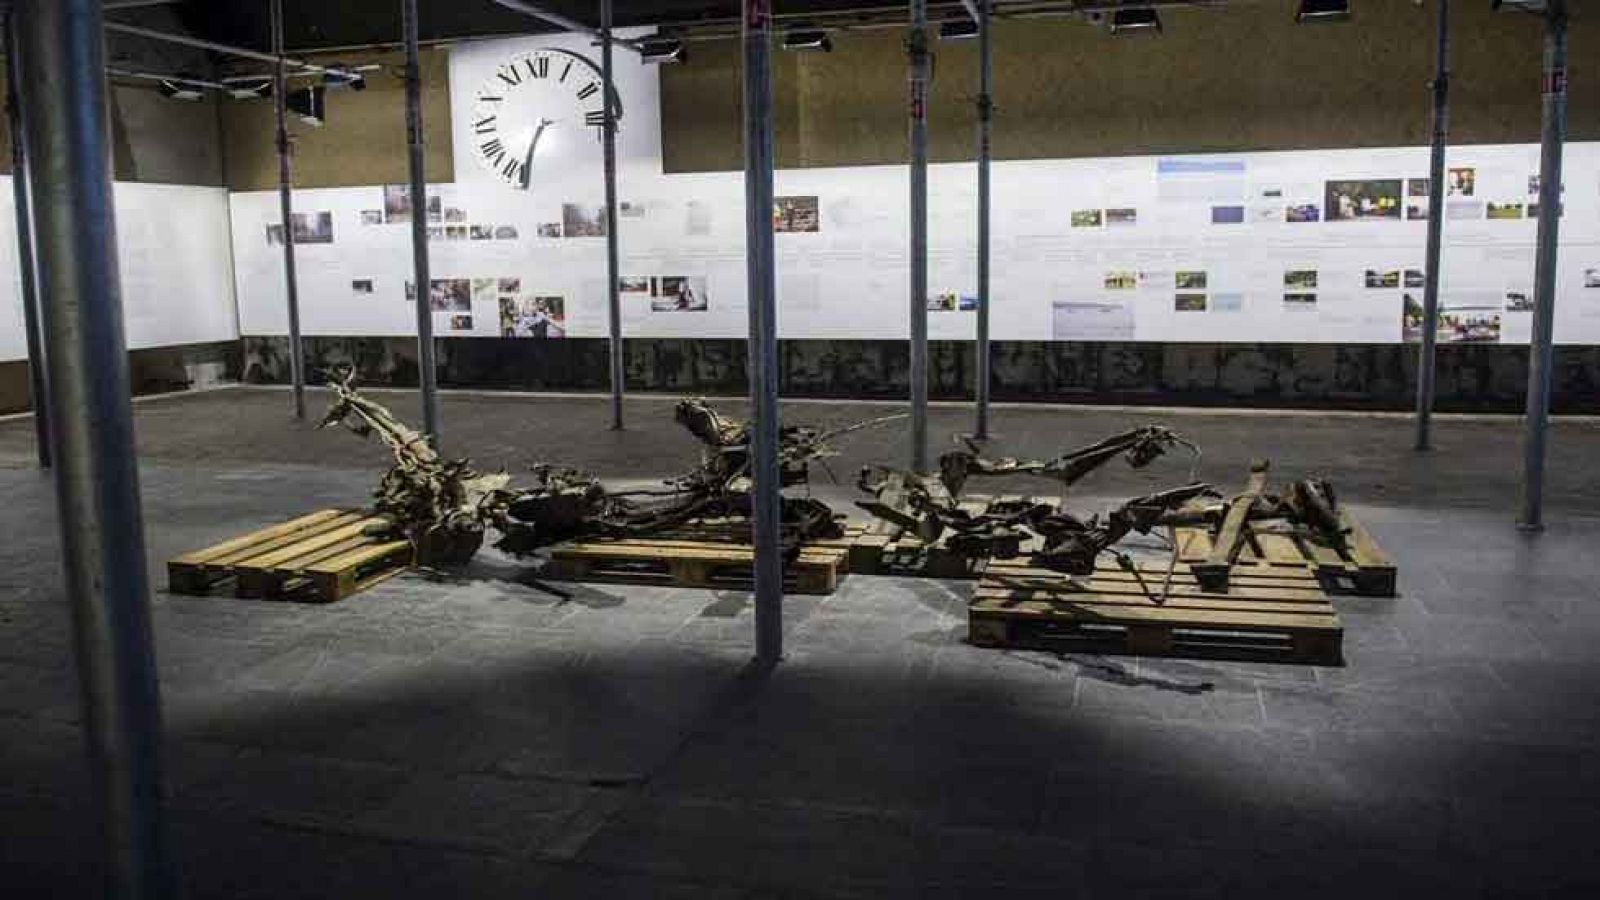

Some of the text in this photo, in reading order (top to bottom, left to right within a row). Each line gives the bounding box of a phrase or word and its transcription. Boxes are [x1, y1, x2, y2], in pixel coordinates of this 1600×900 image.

[497, 65, 522, 86] XI
[525, 56, 549, 79] XII
[559, 60, 573, 83] I
[576, 81, 599, 100] II
[585, 110, 605, 127] III
[480, 137, 506, 168] VIII
